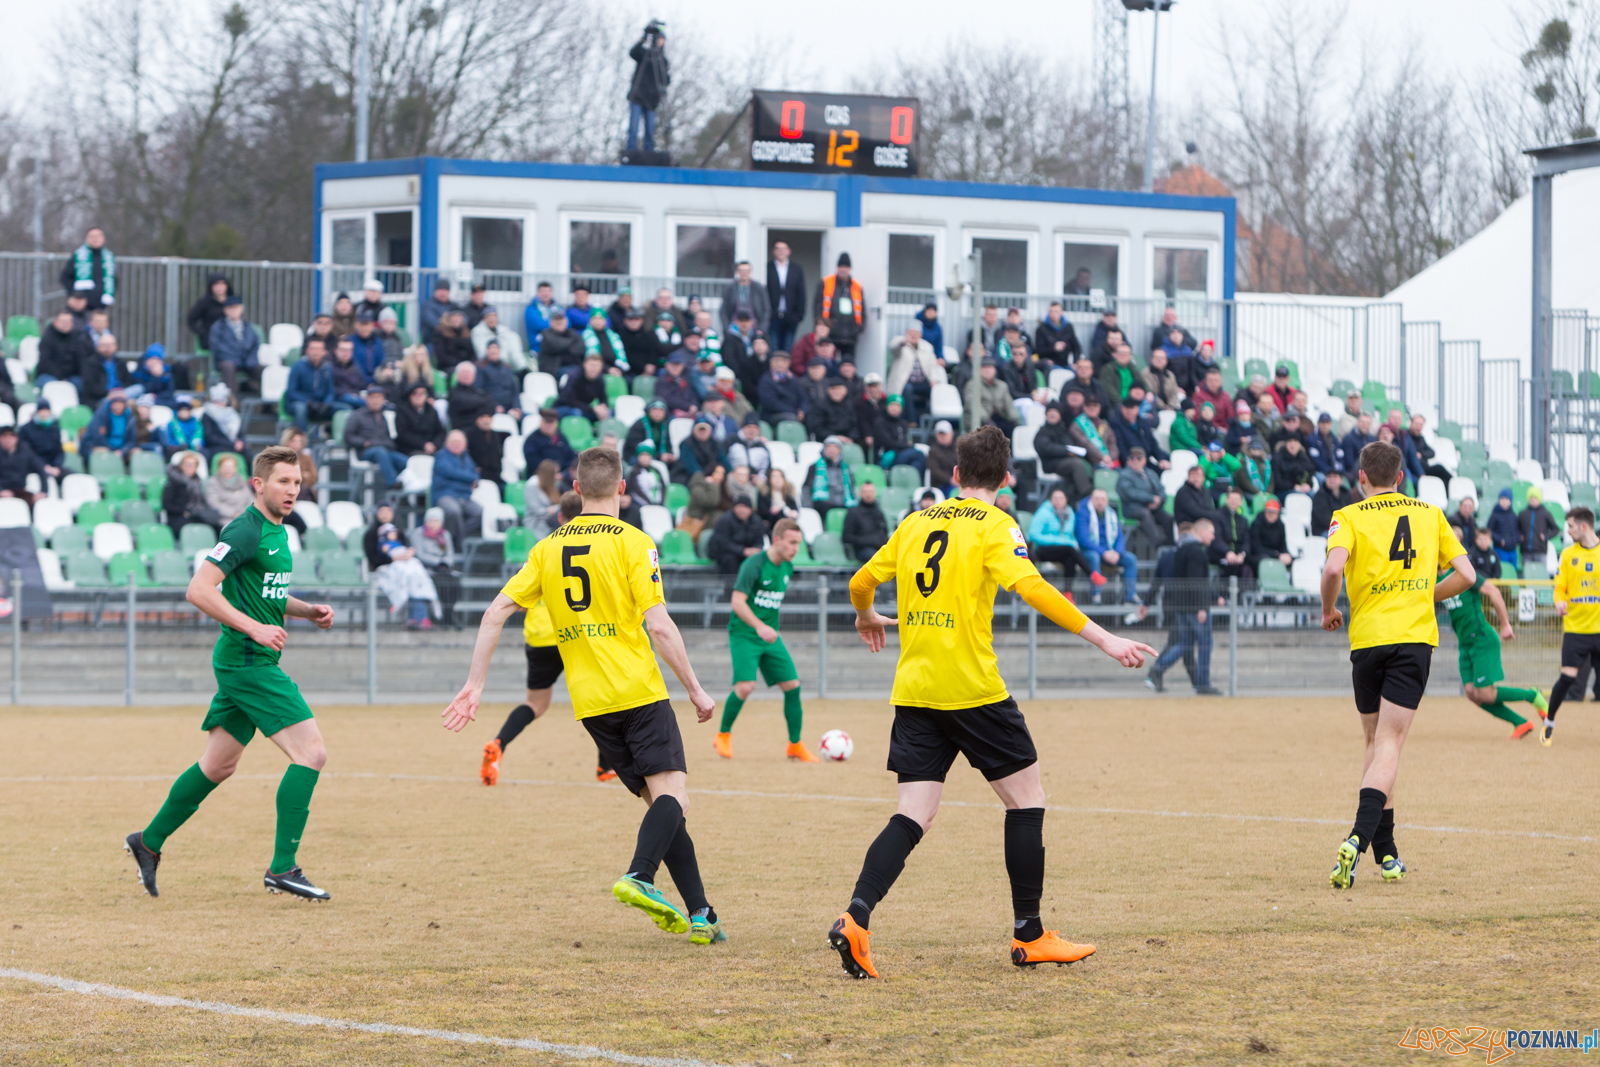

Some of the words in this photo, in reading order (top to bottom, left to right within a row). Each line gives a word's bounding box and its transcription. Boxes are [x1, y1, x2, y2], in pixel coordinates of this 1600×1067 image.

[780, 100, 806, 140] 0
[890, 106, 914, 145] 0
[826, 129, 860, 168] 12
[1389, 515, 1417, 570] 4
[561, 544, 592, 612] 5
[915, 530, 949, 598] 3
[1521, 594, 1534, 614] 33
